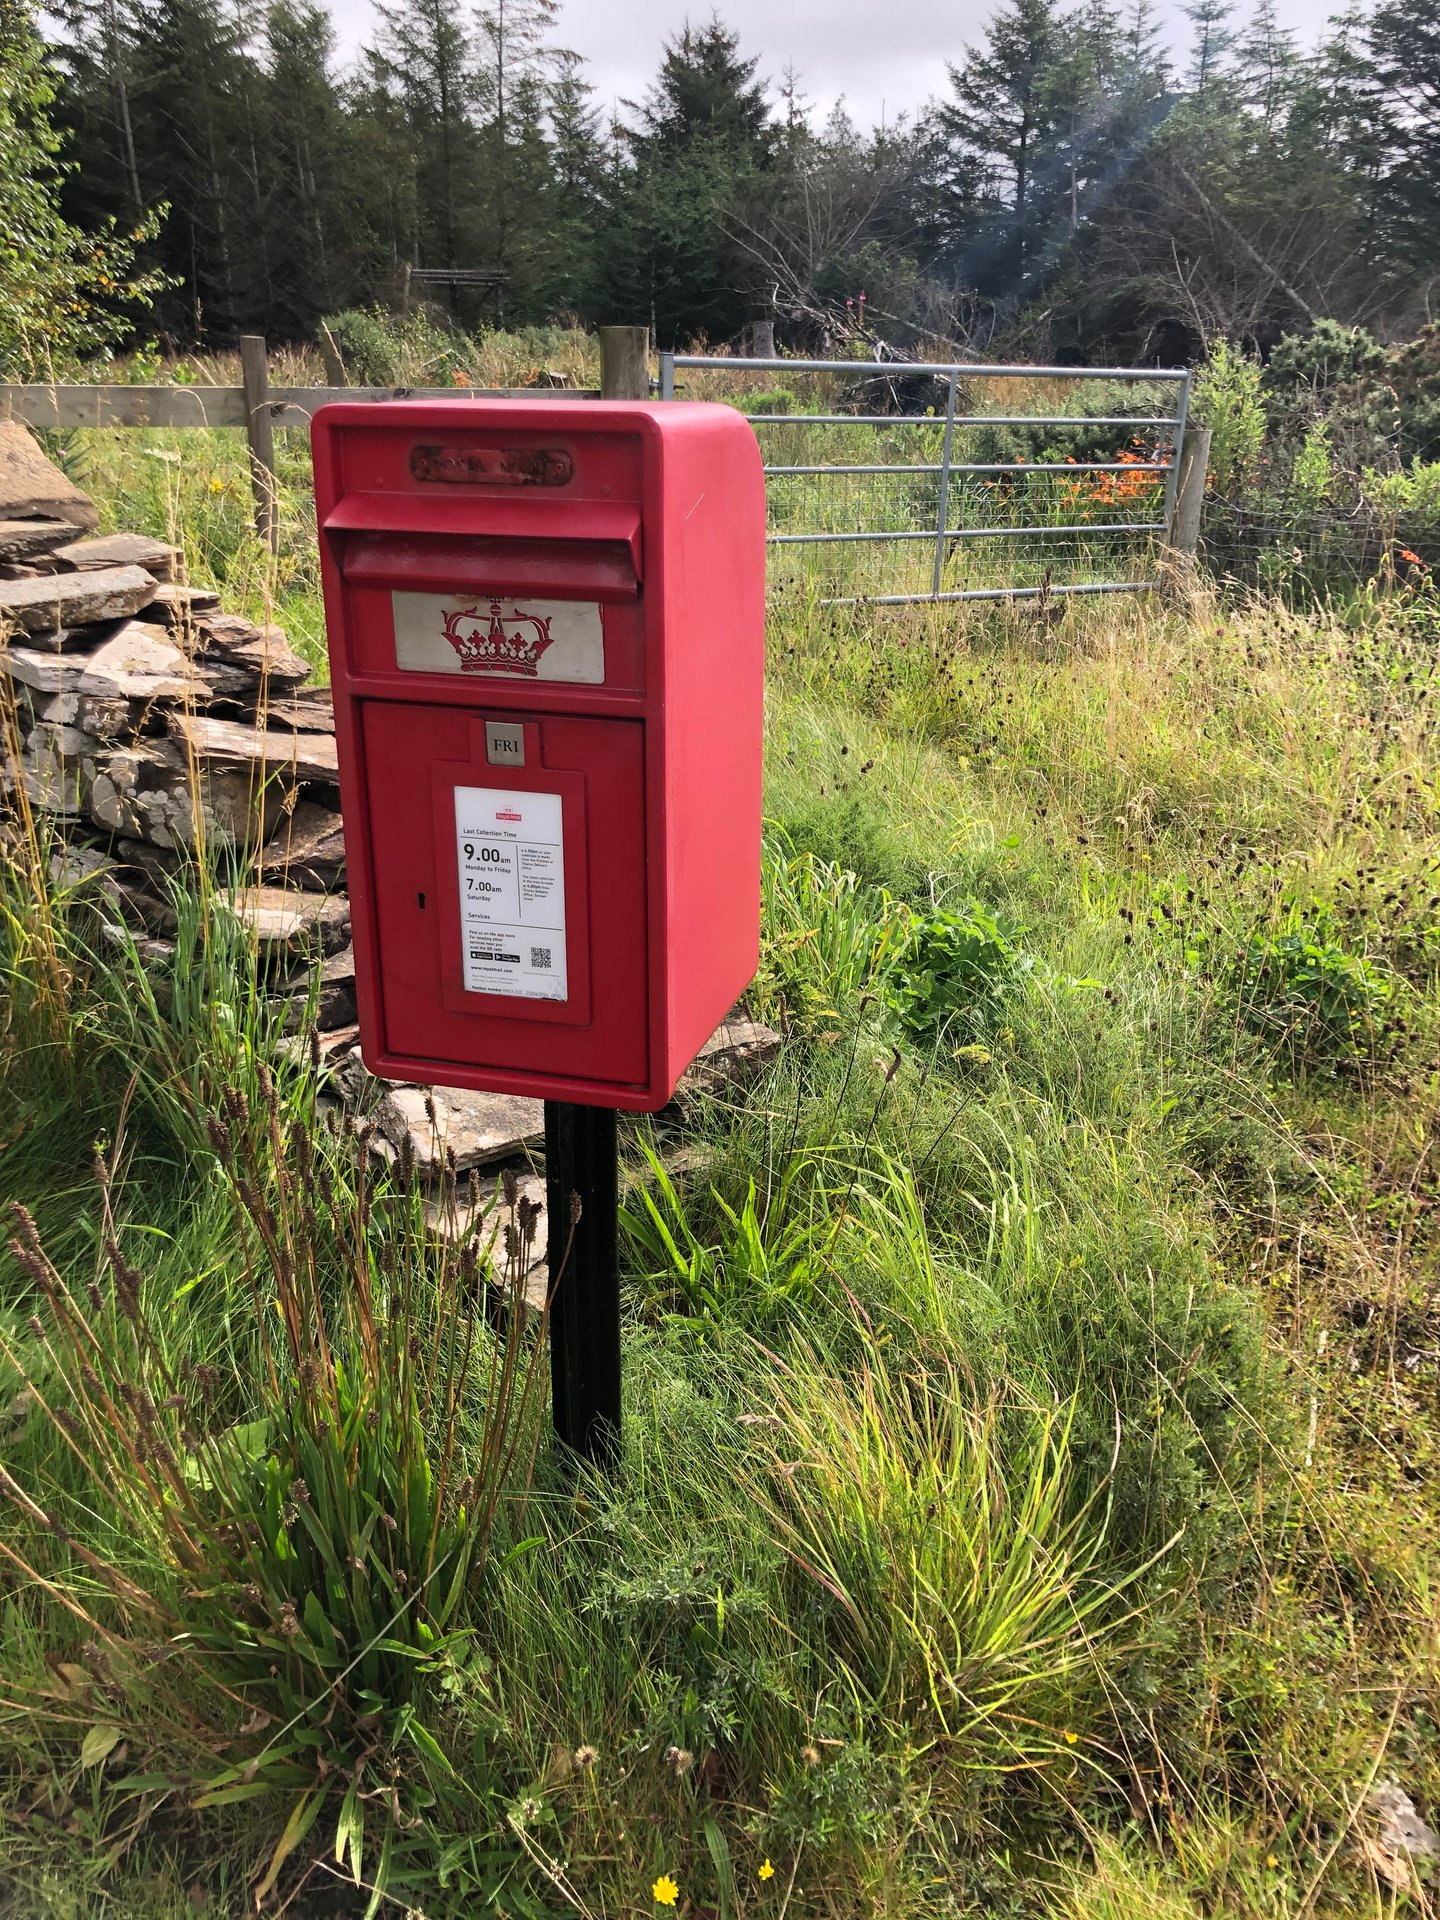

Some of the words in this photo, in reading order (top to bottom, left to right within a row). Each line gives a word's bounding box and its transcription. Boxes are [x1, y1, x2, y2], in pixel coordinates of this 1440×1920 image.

[494, 739, 519, 752] FRI
[464, 844, 511, 864] 9.00am
[466, 878, 502, 893] 7.00am
[467, 894, 491, 902] Saturday
